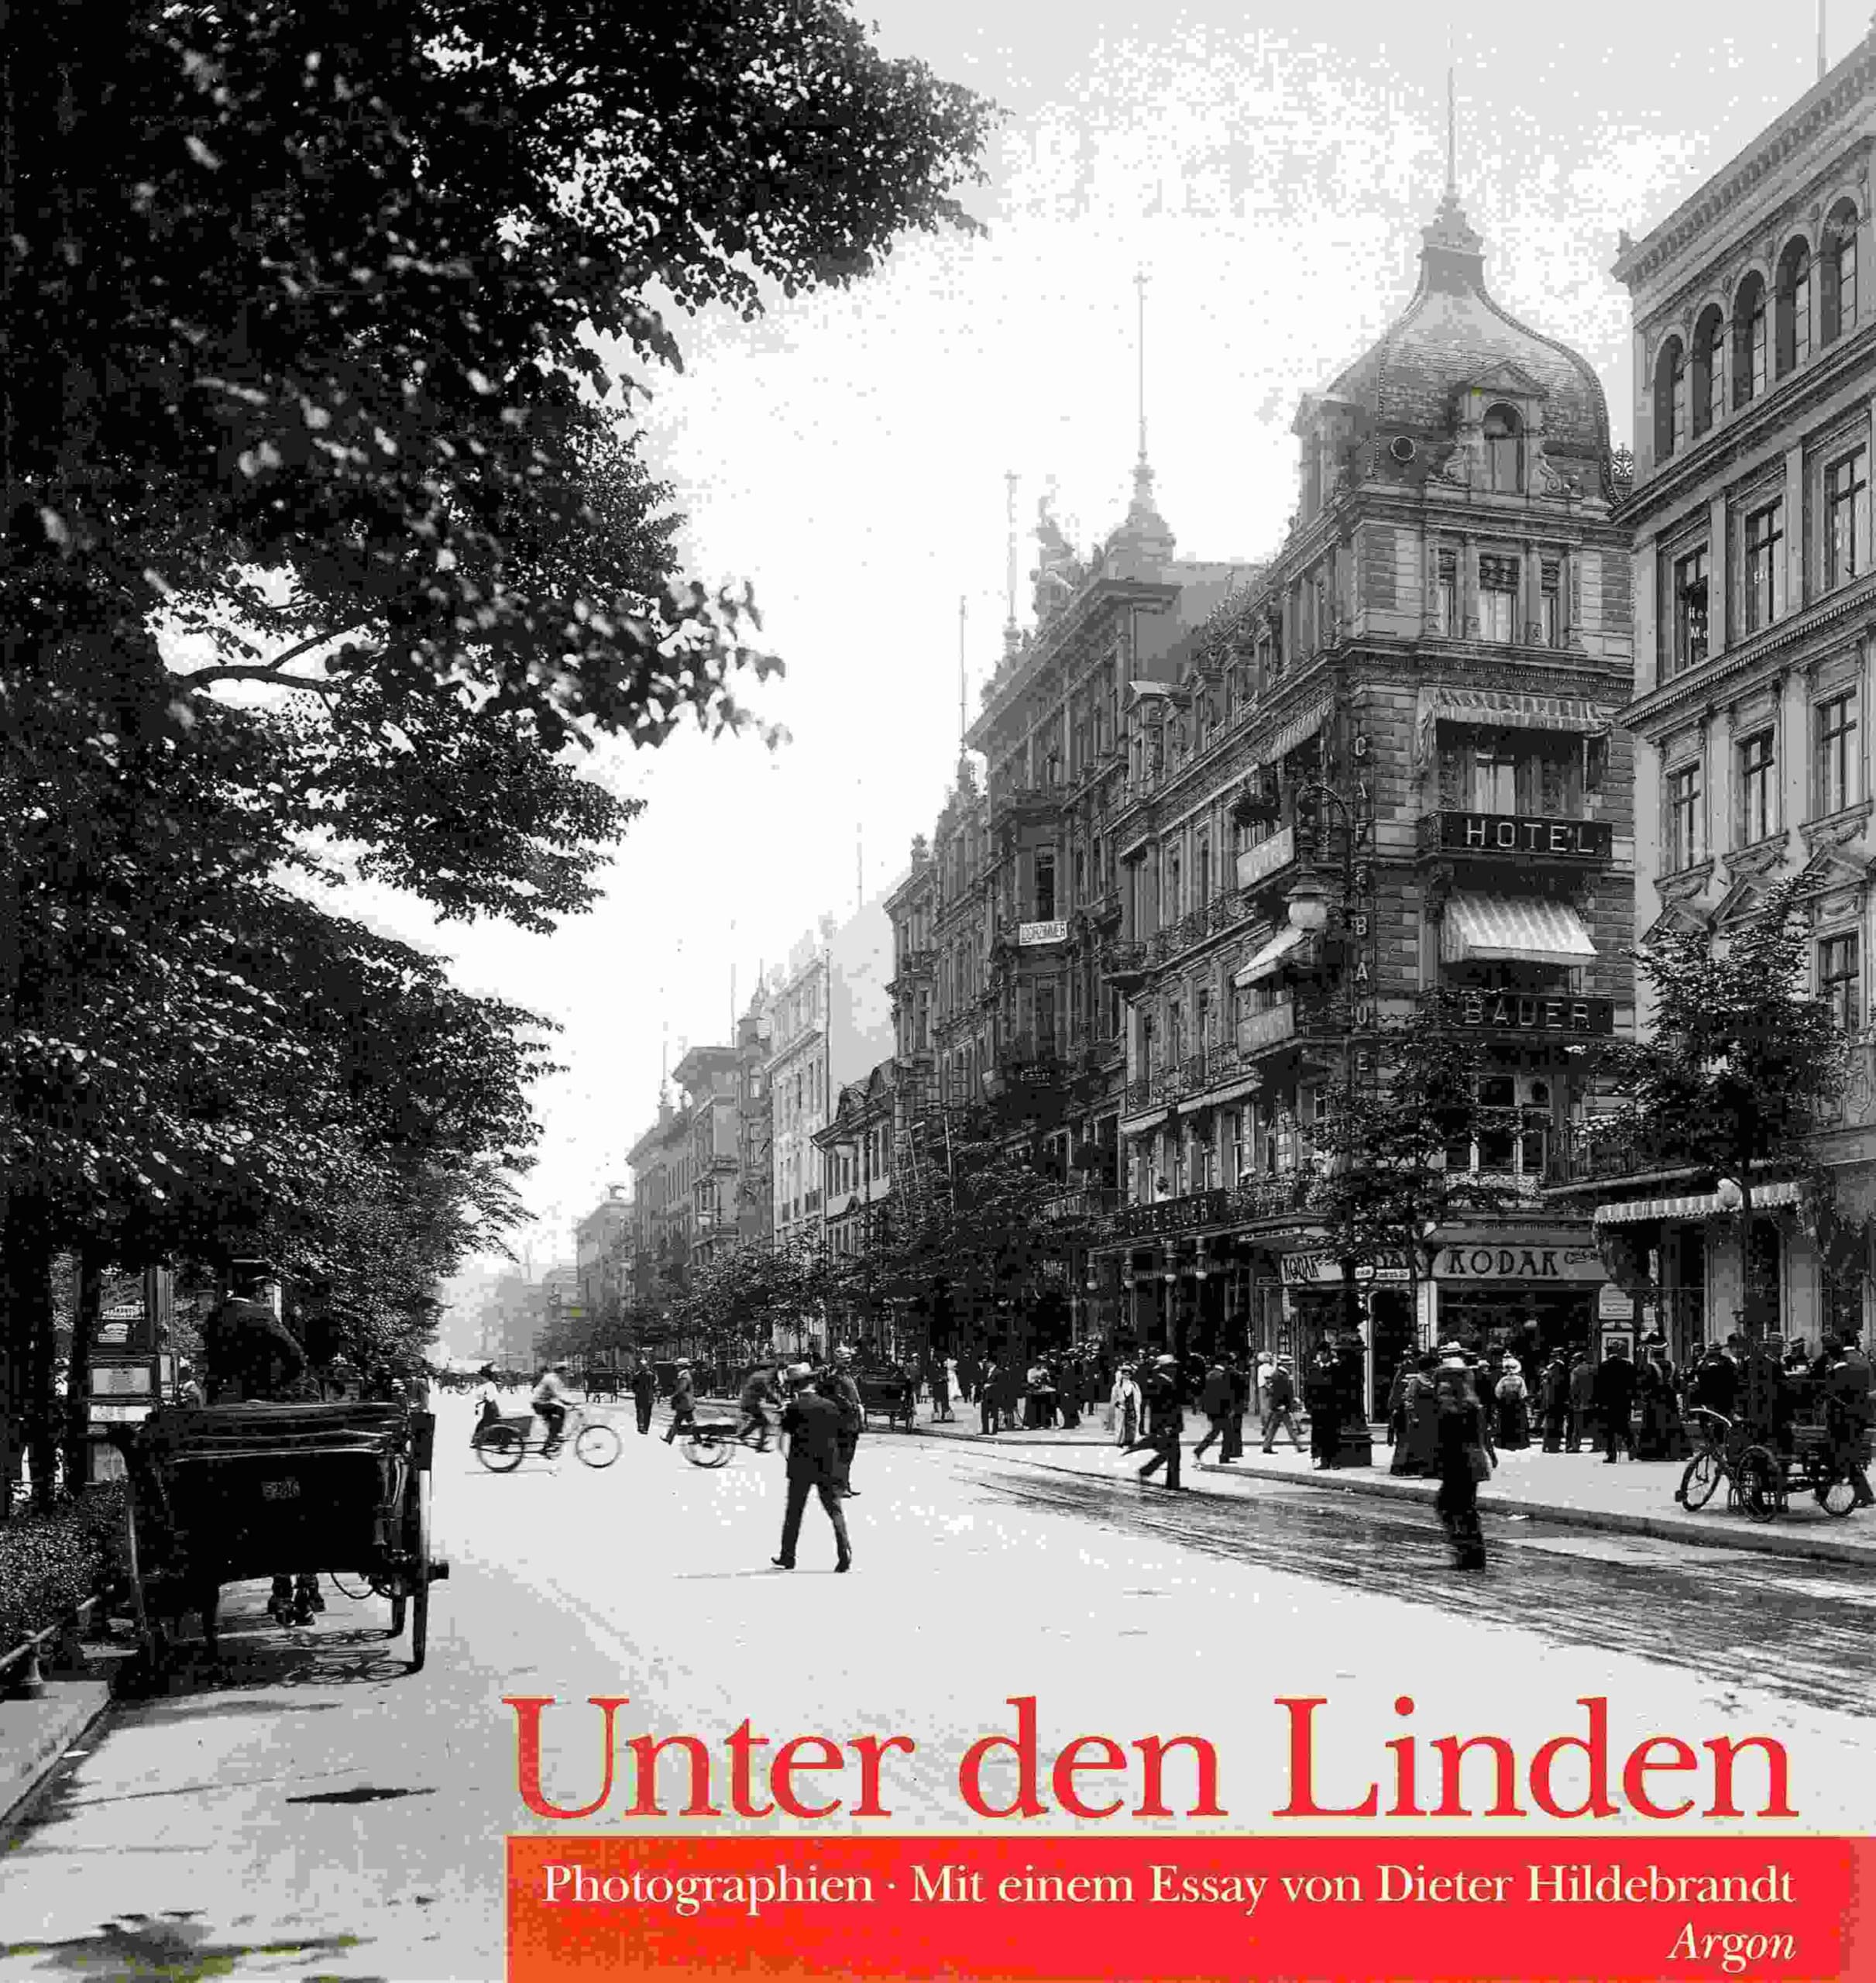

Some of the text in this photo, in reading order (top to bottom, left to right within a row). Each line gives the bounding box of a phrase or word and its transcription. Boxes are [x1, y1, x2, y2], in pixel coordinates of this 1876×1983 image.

[1466, 818, 1595, 853] HOTEL
[1462, 996, 1591, 1028] BAUER
[1447, 1249, 1559, 1276] KODAK
